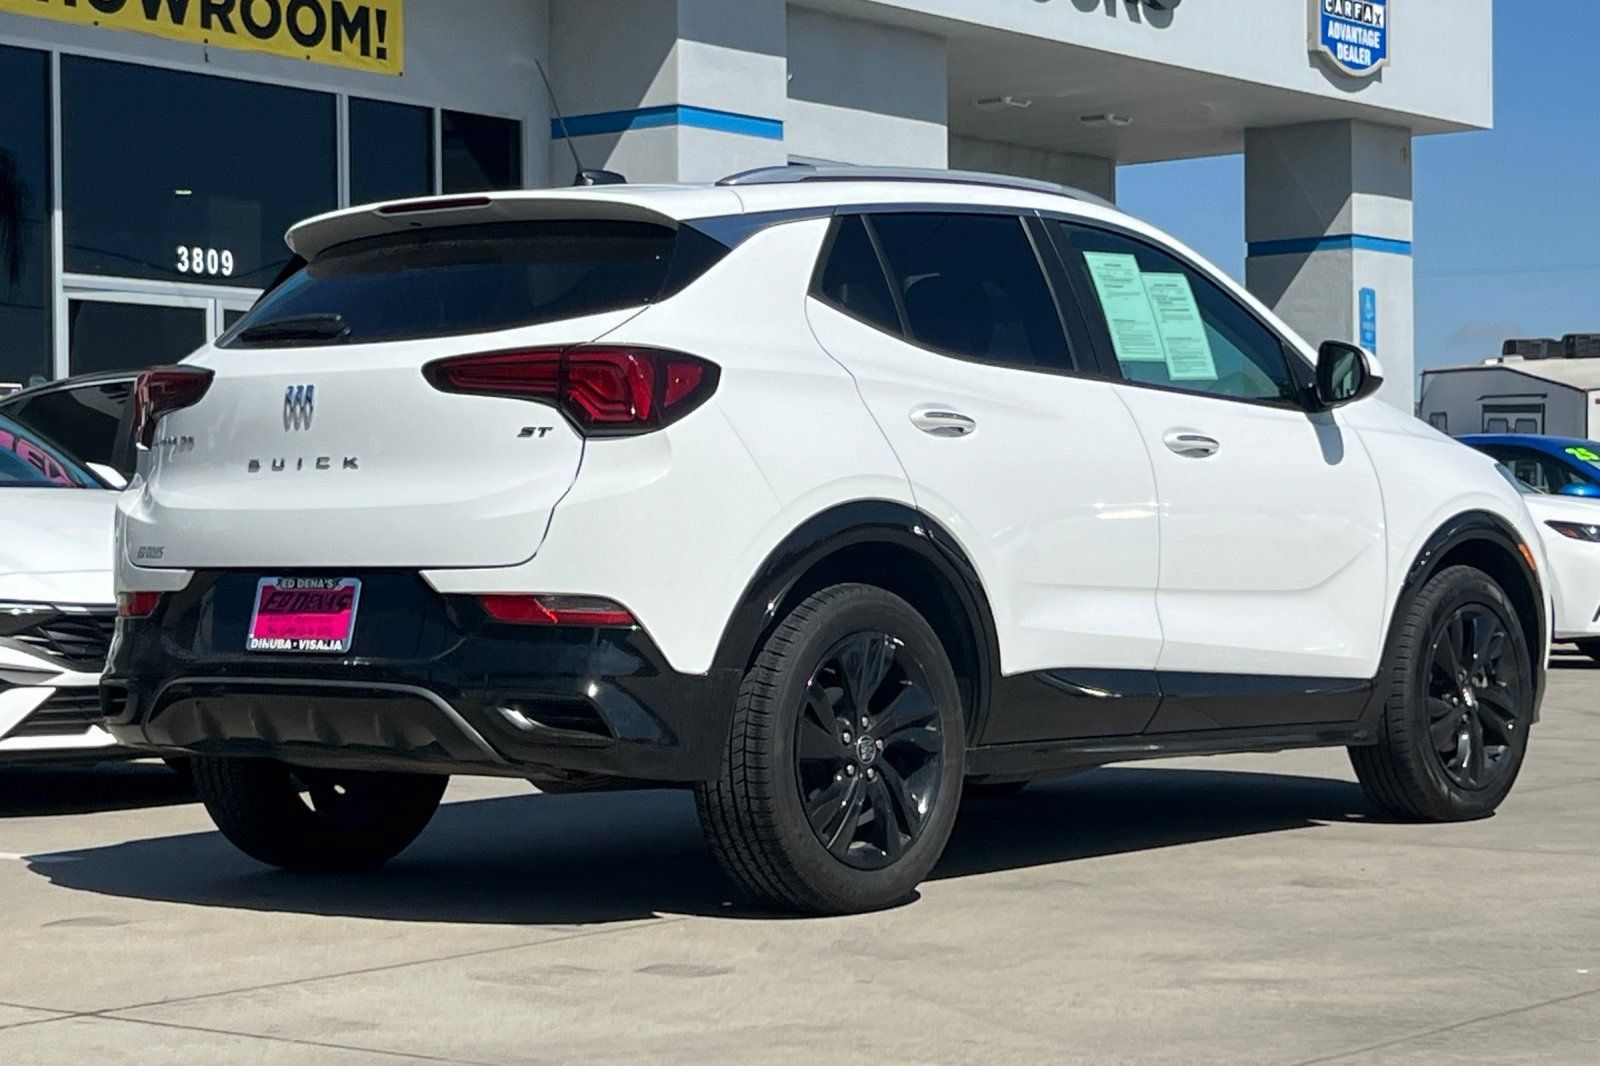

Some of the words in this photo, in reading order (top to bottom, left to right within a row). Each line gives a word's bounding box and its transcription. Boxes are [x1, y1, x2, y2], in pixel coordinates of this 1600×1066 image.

[1325, 0, 1382, 26] CARFAX
[1328, 20, 1381, 48] ADVANTAGE
[1337, 42, 1371, 66] DEALER
[177, 245, 233, 276] 3809
[517, 426, 553, 438] ST
[248, 457, 359, 473] BUICK
[282, 579, 294, 588] ED
[250, 639, 292, 650] DINUBA
[299, 639, 342, 650] VISALIA
